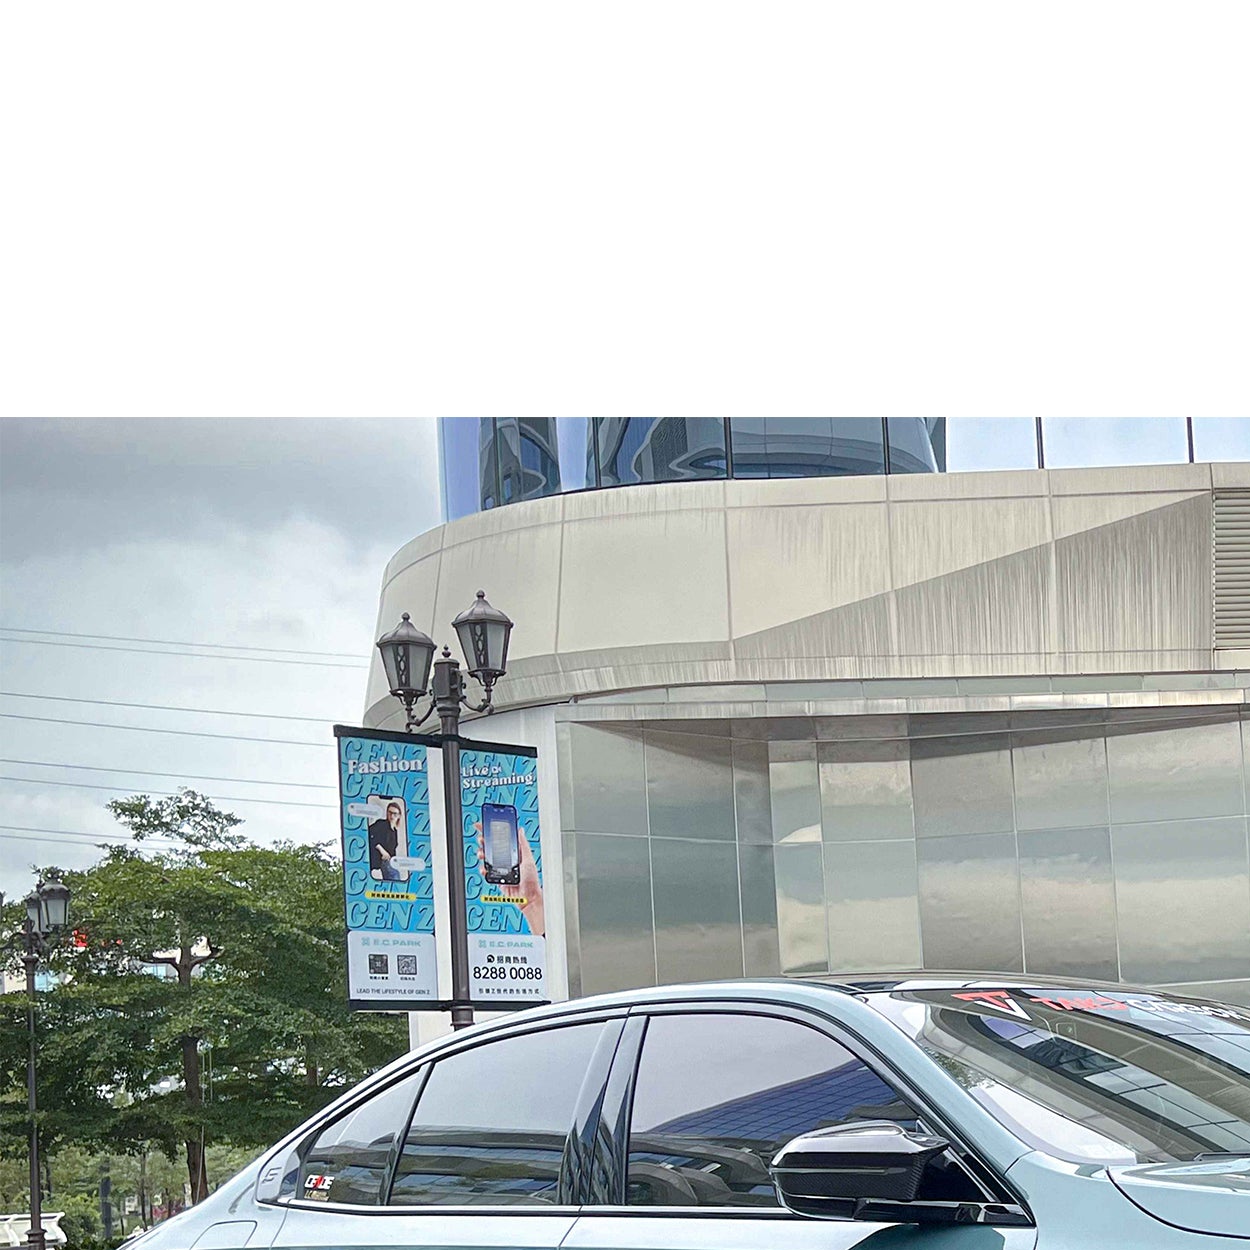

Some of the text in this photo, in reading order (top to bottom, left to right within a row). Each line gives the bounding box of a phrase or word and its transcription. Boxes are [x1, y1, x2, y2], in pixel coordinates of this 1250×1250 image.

[347, 754, 423, 775] Fashion
[462, 765, 489, 777] Live
[462, 772, 534, 788] Streaming
[347, 900, 435, 931] GEN Z
[467, 904, 524, 932] GEN
[473, 966, 542, 980] 8288 0088
